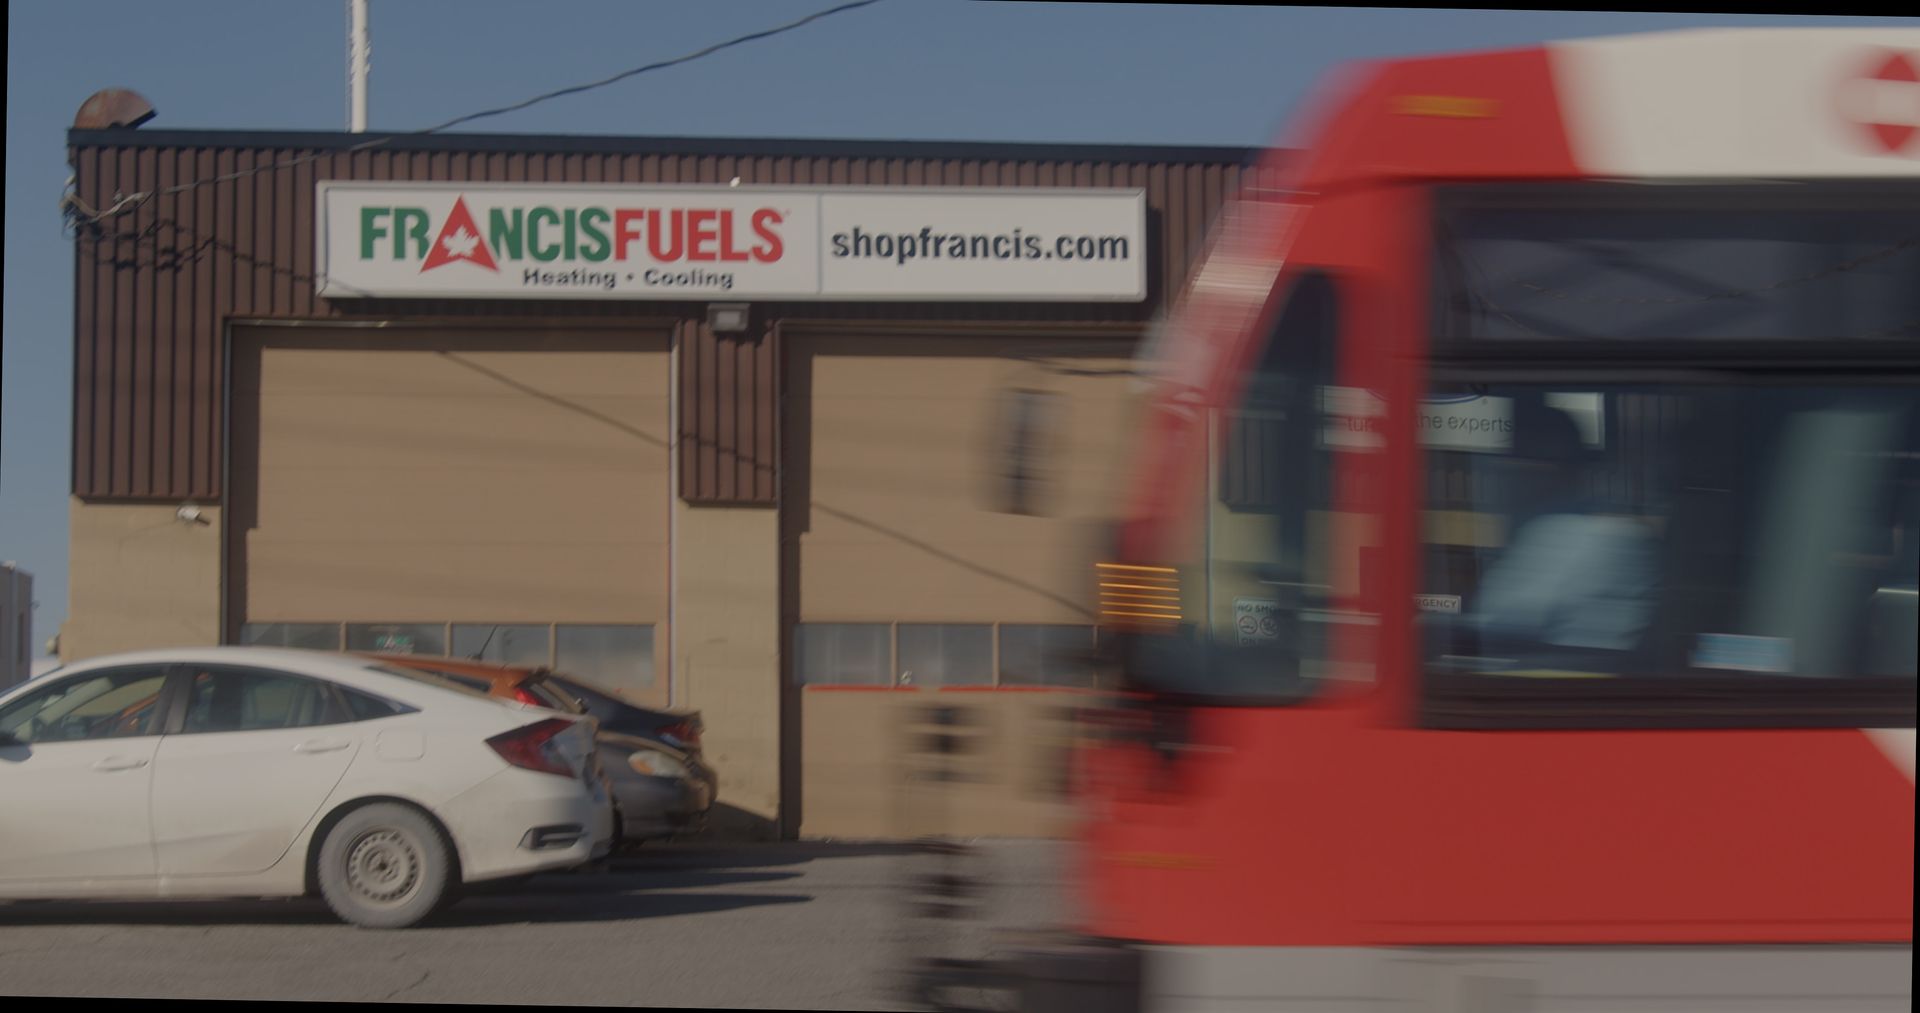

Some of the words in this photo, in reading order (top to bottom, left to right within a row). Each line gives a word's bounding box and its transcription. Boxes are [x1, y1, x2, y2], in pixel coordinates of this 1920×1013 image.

[831, 227, 1129, 264] shopfrancis.com
[523, 268, 616, 289] Heating
[644, 269, 734, 290] Cooling
[1448, 414, 1513, 437] experts
